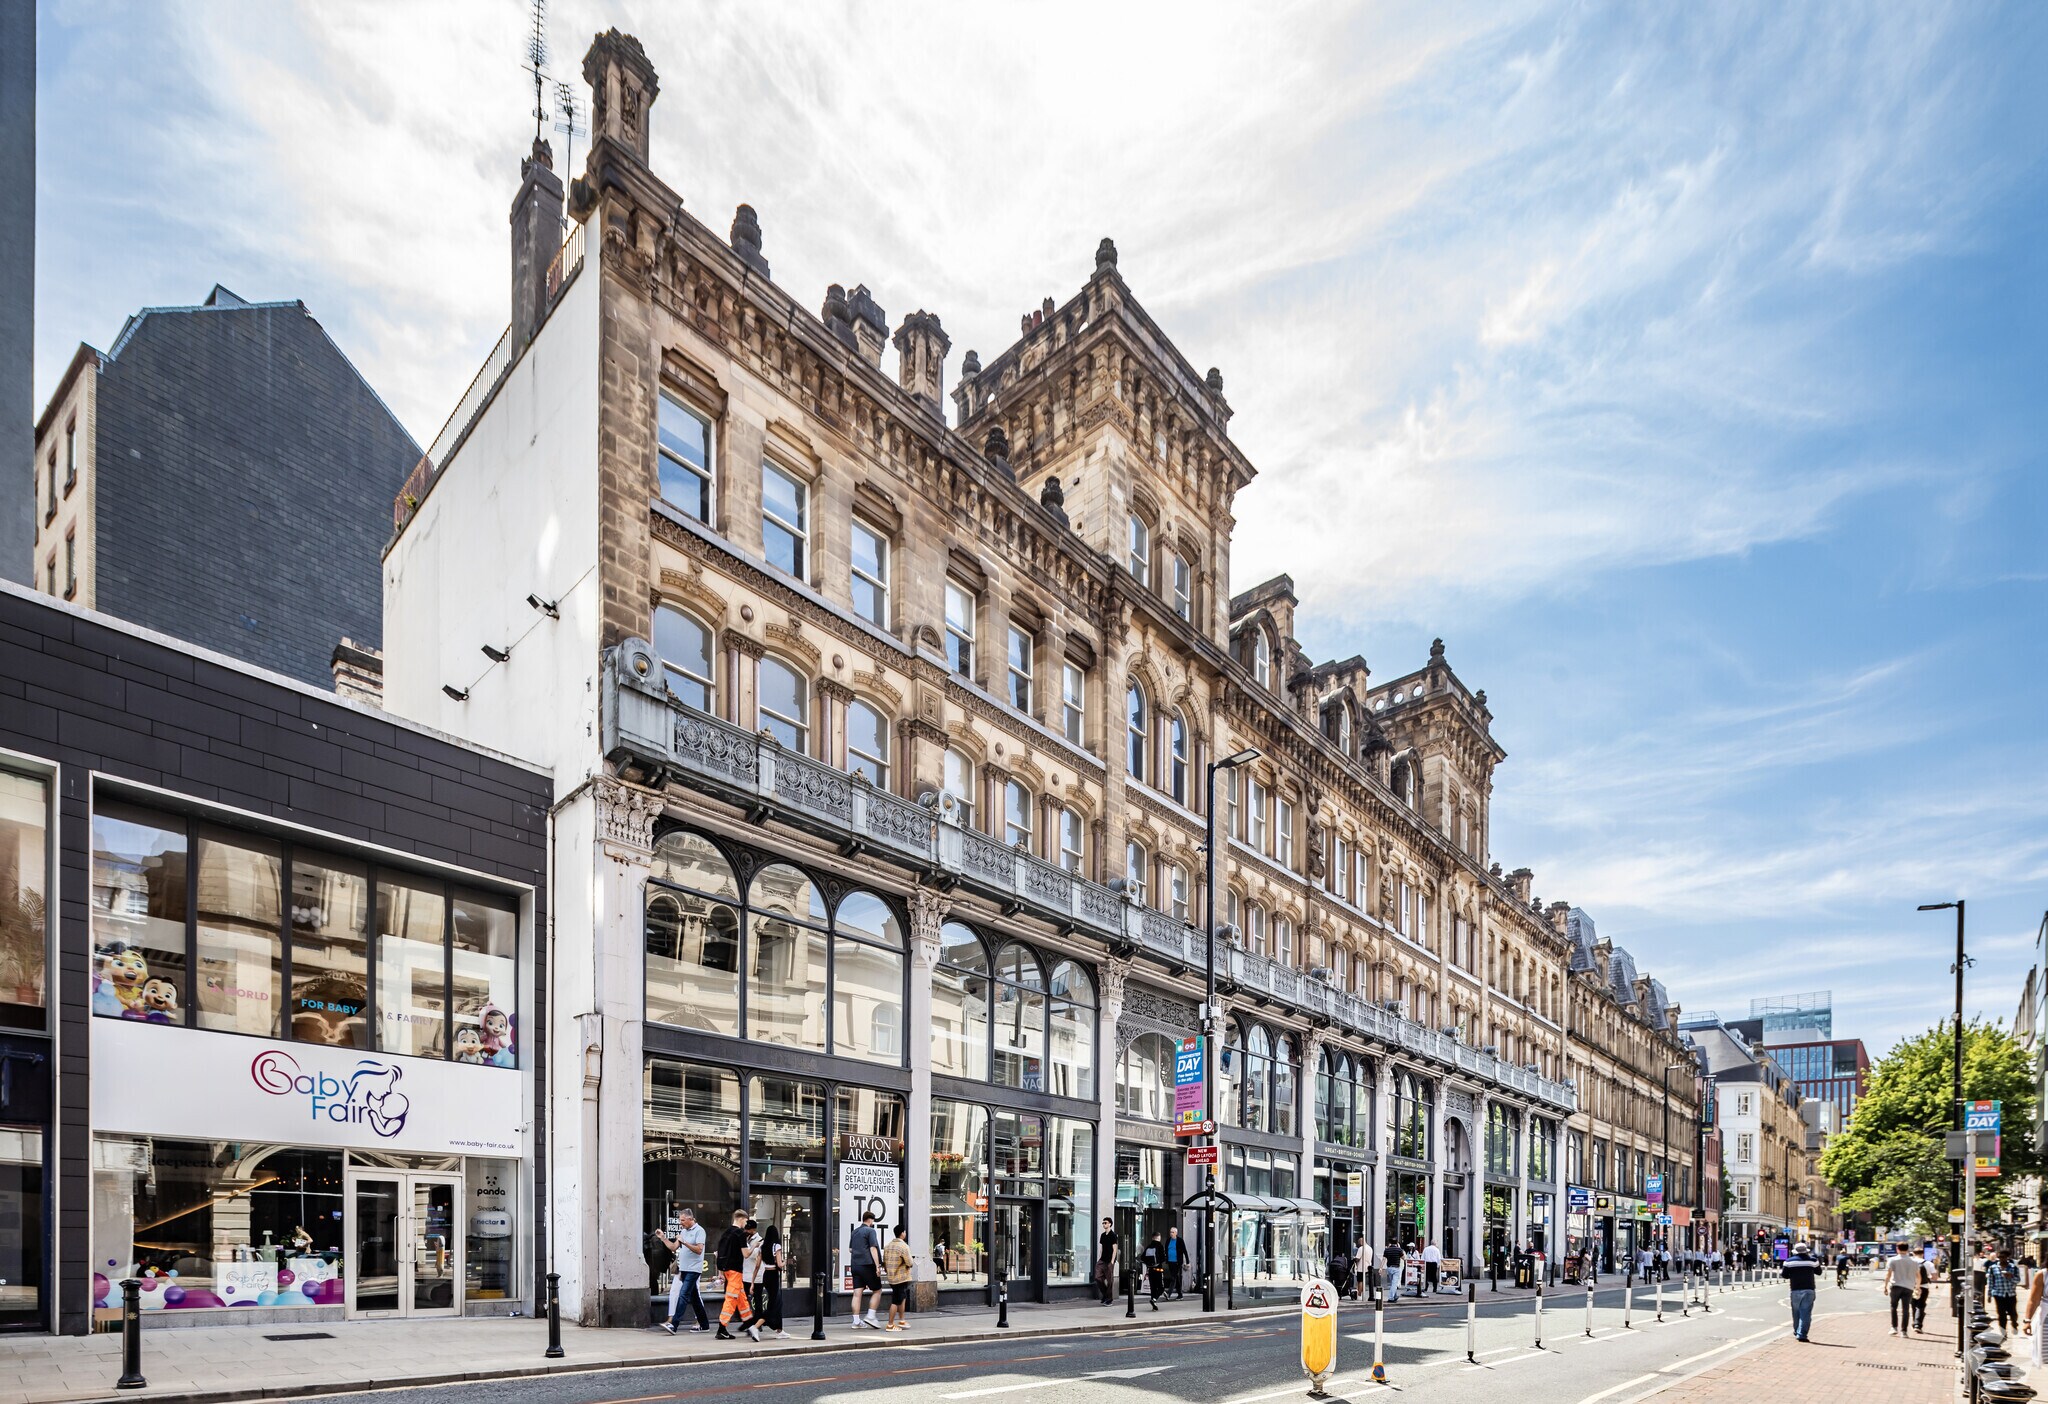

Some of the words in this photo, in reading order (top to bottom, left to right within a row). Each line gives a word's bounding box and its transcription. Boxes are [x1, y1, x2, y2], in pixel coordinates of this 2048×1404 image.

[224, 987, 269, 1001] WORLD
[301, 998, 324, 1010] FOR
[327, 1002, 358, 1015] BABY
[387, 1012, 394, 1020] &
[1177, 1057, 1201, 1073] DAY
[251, 1050, 359, 1103] Baby
[312, 1096, 368, 1124] Fair
[1966, 1117, 1997, 1127] DAY
[449, 1139, 515, 1150] www.baby-fair.co.uk
[849, 1135, 892, 1151] BARTON
[151, 1153, 225, 1169] leepeezee
[847, 1149, 893, 1164] ARCADE
[846, 1167, 894, 1178] OUTSTANDING
[845, 1175, 895, 1185] RETAIL/LEISURE
[476, 1187, 506, 1197] panda
[844, 1183, 896, 1193] OPPORTUNITIES
[853, 1196, 887, 1223] TO
